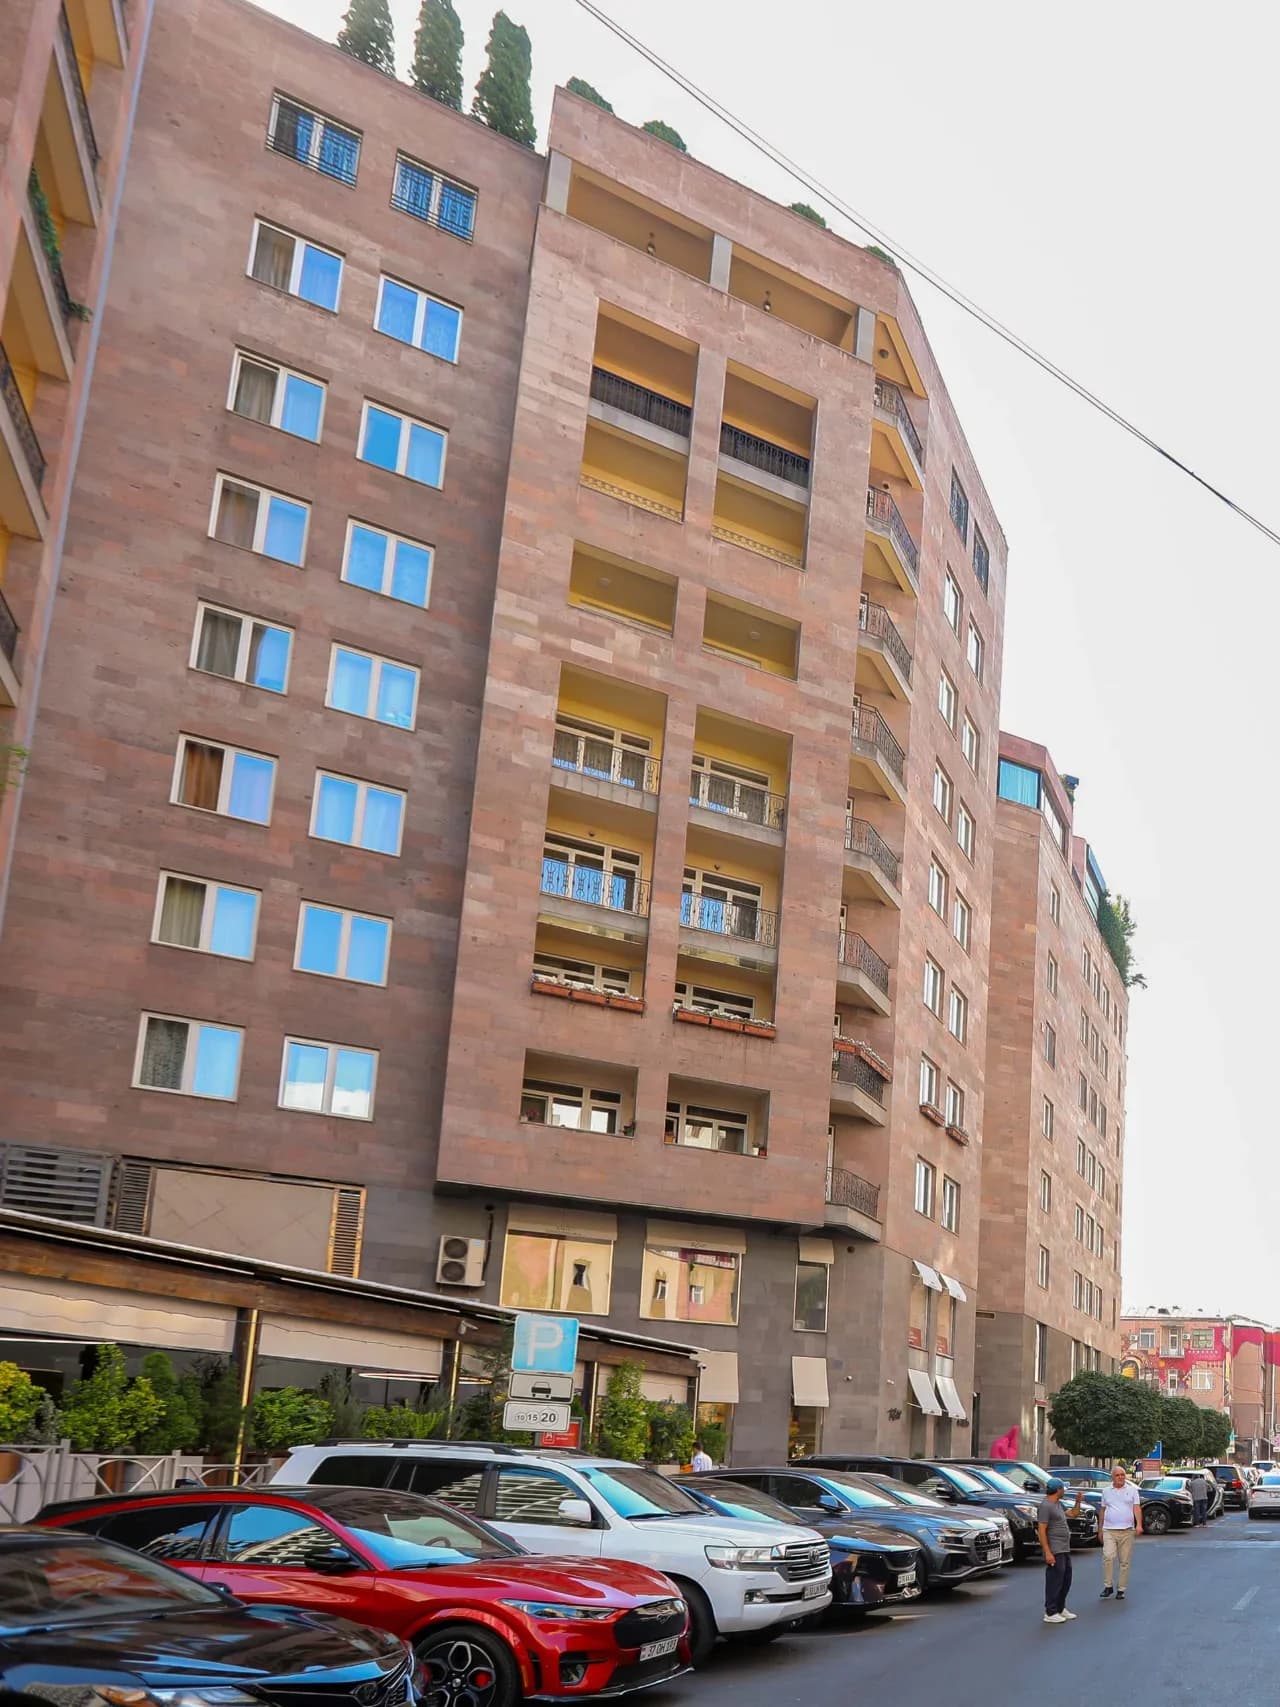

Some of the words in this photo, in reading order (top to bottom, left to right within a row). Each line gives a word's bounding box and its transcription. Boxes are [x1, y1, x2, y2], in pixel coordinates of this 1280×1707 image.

[527, 1321, 563, 1366] P
[528, 1413, 538, 1421] 15
[541, 1412, 556, 1423] 20
